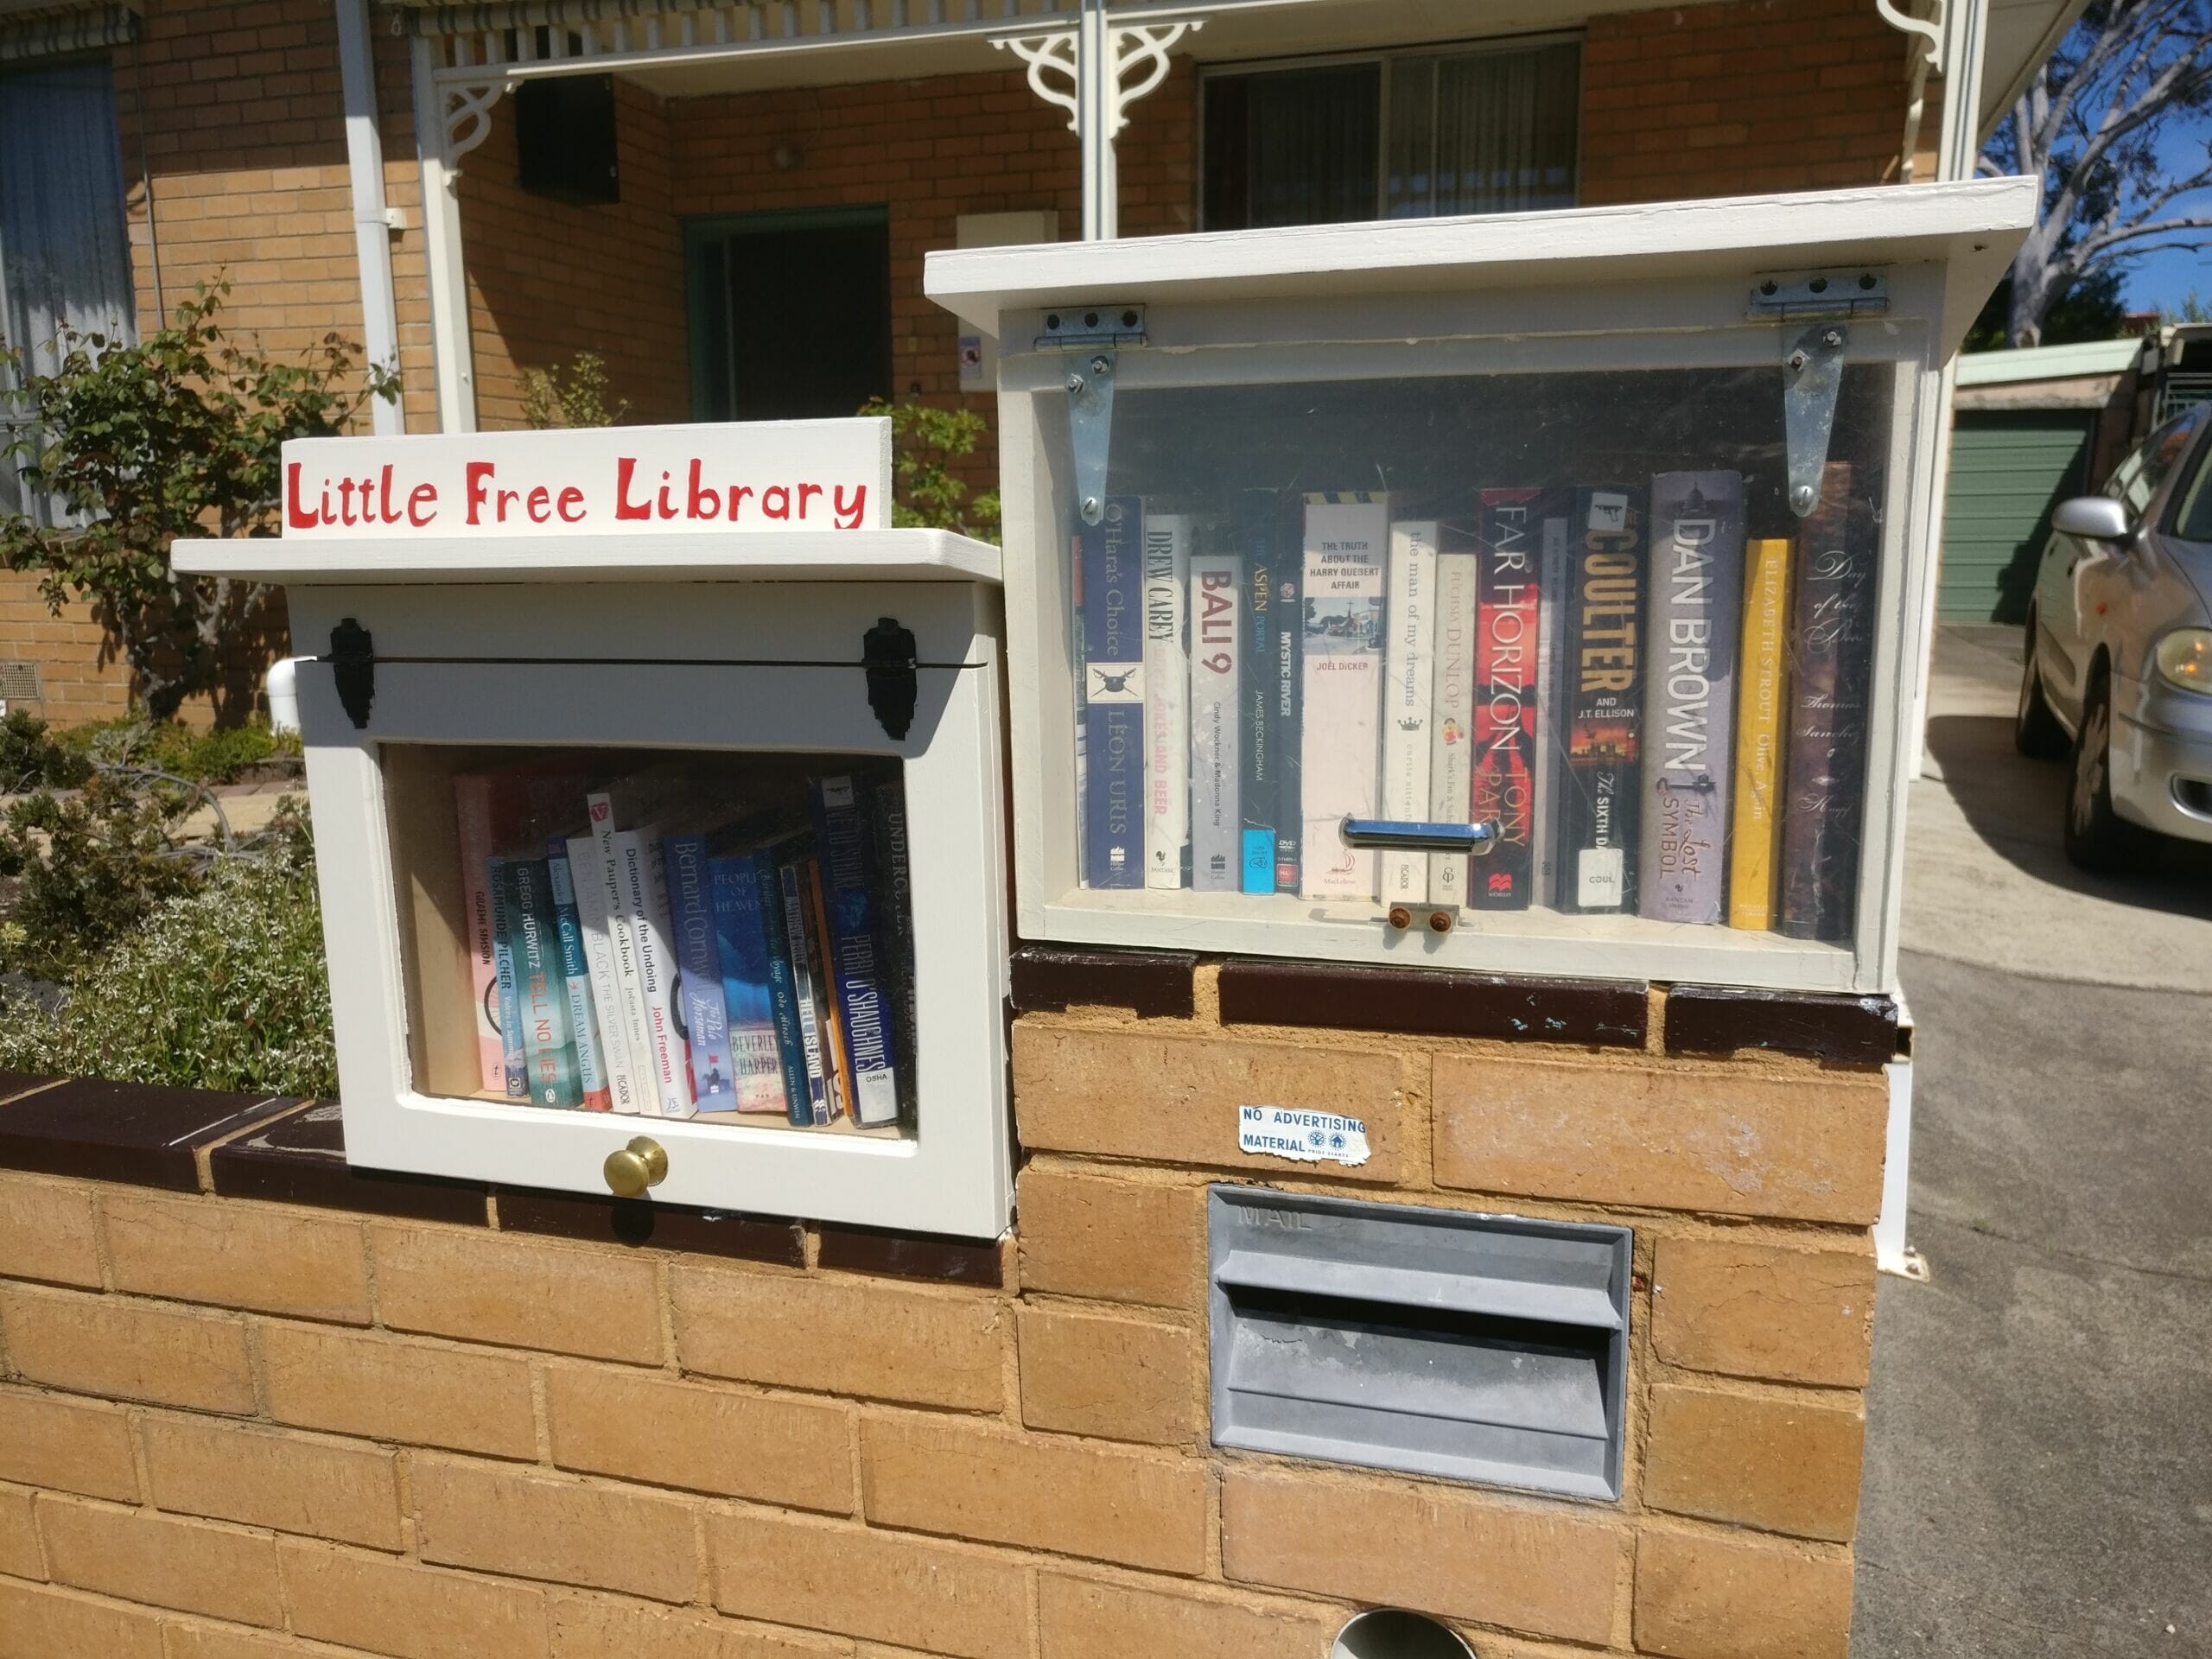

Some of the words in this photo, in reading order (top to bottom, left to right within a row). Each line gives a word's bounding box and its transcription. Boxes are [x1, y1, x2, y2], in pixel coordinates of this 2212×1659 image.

[288, 461, 438, 529] Little
[466, 461, 587, 528] Free
[615, 457, 866, 529] Library
[1104, 503, 1122, 583] O'Hara's
[1147, 531, 1173, 582] DREW
[1320, 555, 1351, 564] ABOUT
[1352, 554, 1369, 563] THE
[1321, 542, 1338, 550] THE
[1339, 541, 1368, 550] TRUTH
[1409, 531, 1421, 557] the
[1493, 506, 1527, 575] FAR
[1310, 568, 1338, 576] HARRY
[1340, 567, 1379, 576] QUEBERT
[1408, 563, 1418, 597] man
[1670, 518, 1716, 605] DAN
[1806, 550, 1866, 588] Day
[1254, 563, 1268, 612] ASPEN
[1331, 581, 1359, 589] AFFAIR
[1105, 588, 1125, 656] Choice
[1147, 587, 1173, 643] CAREY
[1201, 570, 1232, 644] BALI
[1408, 604, 1419, 620] of
[1580, 528, 1638, 692] COULTER
[1762, 559, 1777, 651] ELIZABETH
[1814, 593, 1839, 619] of
[1834, 593, 1859, 610] the
[1255, 615, 1266, 655] PORTAL
[1404, 624, 1417, 648] my
[1201, 652, 1233, 674] 9
[1280, 632, 1292, 678] MYSTIC
[1445, 628, 1461, 709] DUNLOP
[1490, 584, 1526, 750] HORIZON
[1280, 679, 1292, 717] RIVER
[1405, 652, 1418, 707] dreams
[1664, 619, 1713, 770] BROWN
[1758, 657, 1772, 721] STROUT
[1212, 701, 1221, 723] Cindy
[1255, 690, 1264, 719] JAMES
[1578, 709, 1592, 719] J.T.
[1595, 709, 1634, 718] ELLISON
[1596, 697, 1617, 706] AND
[1800, 693, 1859, 709] Thomas
[1154, 745, 1168, 774] AND
[1255, 720, 1264, 781] BECKINGHAM
[1154, 779, 1168, 815] BEER
[1404, 781, 1414, 822] sittenf
[1478, 771, 1502, 824] PAR
[1597, 772, 1615, 794] The
[1109, 781, 1127, 834] URIS
[1212, 809, 1221, 827] King
[1503, 766, 1528, 848] TONY
[1596, 798, 1611, 834] SIXTH
[1685, 799, 1704, 824] The
[601, 830, 613, 854] New
[1595, 836, 1608, 849] DA
[1659, 798, 1680, 880] SYMBOL
[1678, 830, 1712, 881] Lost
[518, 868, 534, 909] GREGG
[553, 863, 564, 901] Alexander
[606, 858, 621, 911] Pauper's
[626, 848, 644, 908] Dictionary
[674, 842, 707, 913] Bernard
[731, 886, 747, 897] OF
[475, 891, 487, 927] GRAEME
[491, 866, 508, 938] ROSAMUNDE
[636, 910, 648, 922] of
[522, 912, 541, 969] HURWITZ
[558, 906, 574, 943] McCall
[638, 923, 650, 943] the
[479, 928, 492, 966] SIMSION
[497, 940, 512, 989] PILCHER
[564, 945, 579, 976] Smith
[592, 932, 610, 980] BLACK
[614, 914, 634, 977] Cookbook
[683, 913, 717, 992] Cornwell
[841, 934, 873, 975] PERRI
[642, 945, 658, 993] Undoing
[769, 956, 785, 984] Voyage
[504, 995, 513, 1020] Voices
[529, 970, 549, 1014] TELL
[601, 986, 613, 1003] THE
[777, 991, 785, 1008] Odo
[505, 1020, 513, 1029] in
[534, 1019, 552, 1043] NO
[606, 1004, 617, 1037] SILVER
[632, 1019, 641, 1041] Innes
[689, 991, 709, 1046] Horseman
[707, 1018, 724, 1040] Pale
[779, 1012, 793, 1047] Hirsch
[799, 998, 816, 1032] HELL
[845, 978, 887, 1072] O'SHAUGHNES
[571, 995, 585, 1037] DREAM
[579, 1042, 593, 1084] ANGUS
[612, 1039, 624, 1068] SWAN
[652, 1006, 664, 1033] John
[658, 1034, 672, 1084] Freeman
[804, 1033, 821, 1078] ISLAND
[537, 1047, 557, 1085] LIES
[739, 1057, 779, 1076] HARPER
[787, 1065, 796, 1086] ALLEN
[616, 1074, 631, 1105] PICADOR
[1243, 1109, 1262, 1122] NO
[1274, 1111, 1366, 1134] ADVERTISING
[1243, 1134, 1306, 1153] MATERIAL
[1237, 1205, 1314, 1231] MAIL
